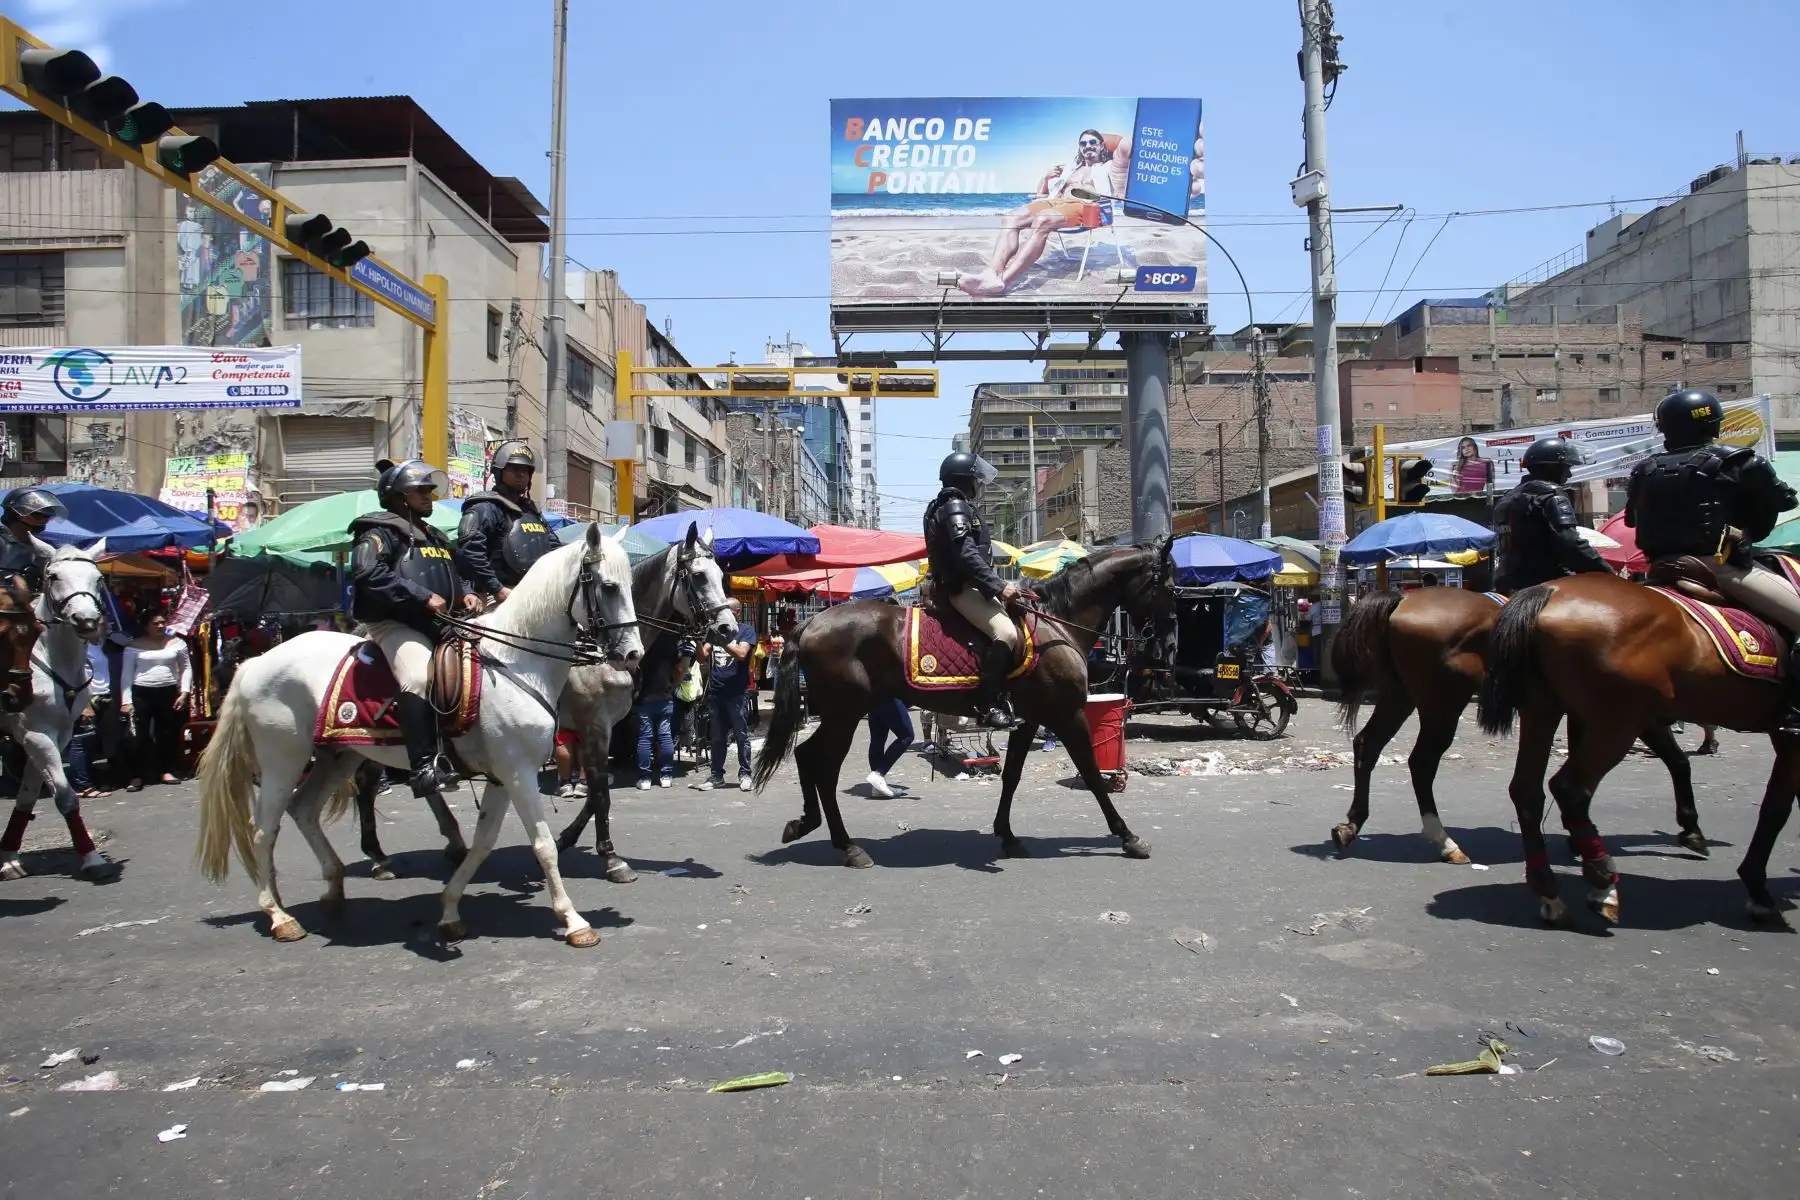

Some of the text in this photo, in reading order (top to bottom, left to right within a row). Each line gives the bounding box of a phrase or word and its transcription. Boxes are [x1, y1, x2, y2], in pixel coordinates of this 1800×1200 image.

[845, 117, 992, 141] BANCO DE
[1141, 126, 1164, 137] ESTE
[1140, 138, 1178, 151] VERANO
[854, 139, 976, 168] CRÉDITO
[1139, 149, 1189, 165] CUALQUIER
[1137, 161, 1182, 176] BANCO ES
[867, 166, 1003, 195] PORTÁTIL
[1136, 172, 1168, 185] TU BCP
[1152, 272, 1180, 285] BCP
[354, 261, 432, 315] AV. HIPOLITO UNANUE
[210, 351, 249, 363] Lava
[235, 362, 260, 371] mejor
[211, 368, 291, 382] Competencia
[240, 386, 256, 395] 994
[1690, 405, 1713, 420] USE
[1585, 428, 1625, 440] Gamarra
[1627, 425, 1644, 435] 1331
[172, 490, 210, 498] COMPLEJ
[218, 505, 239, 520] 30
